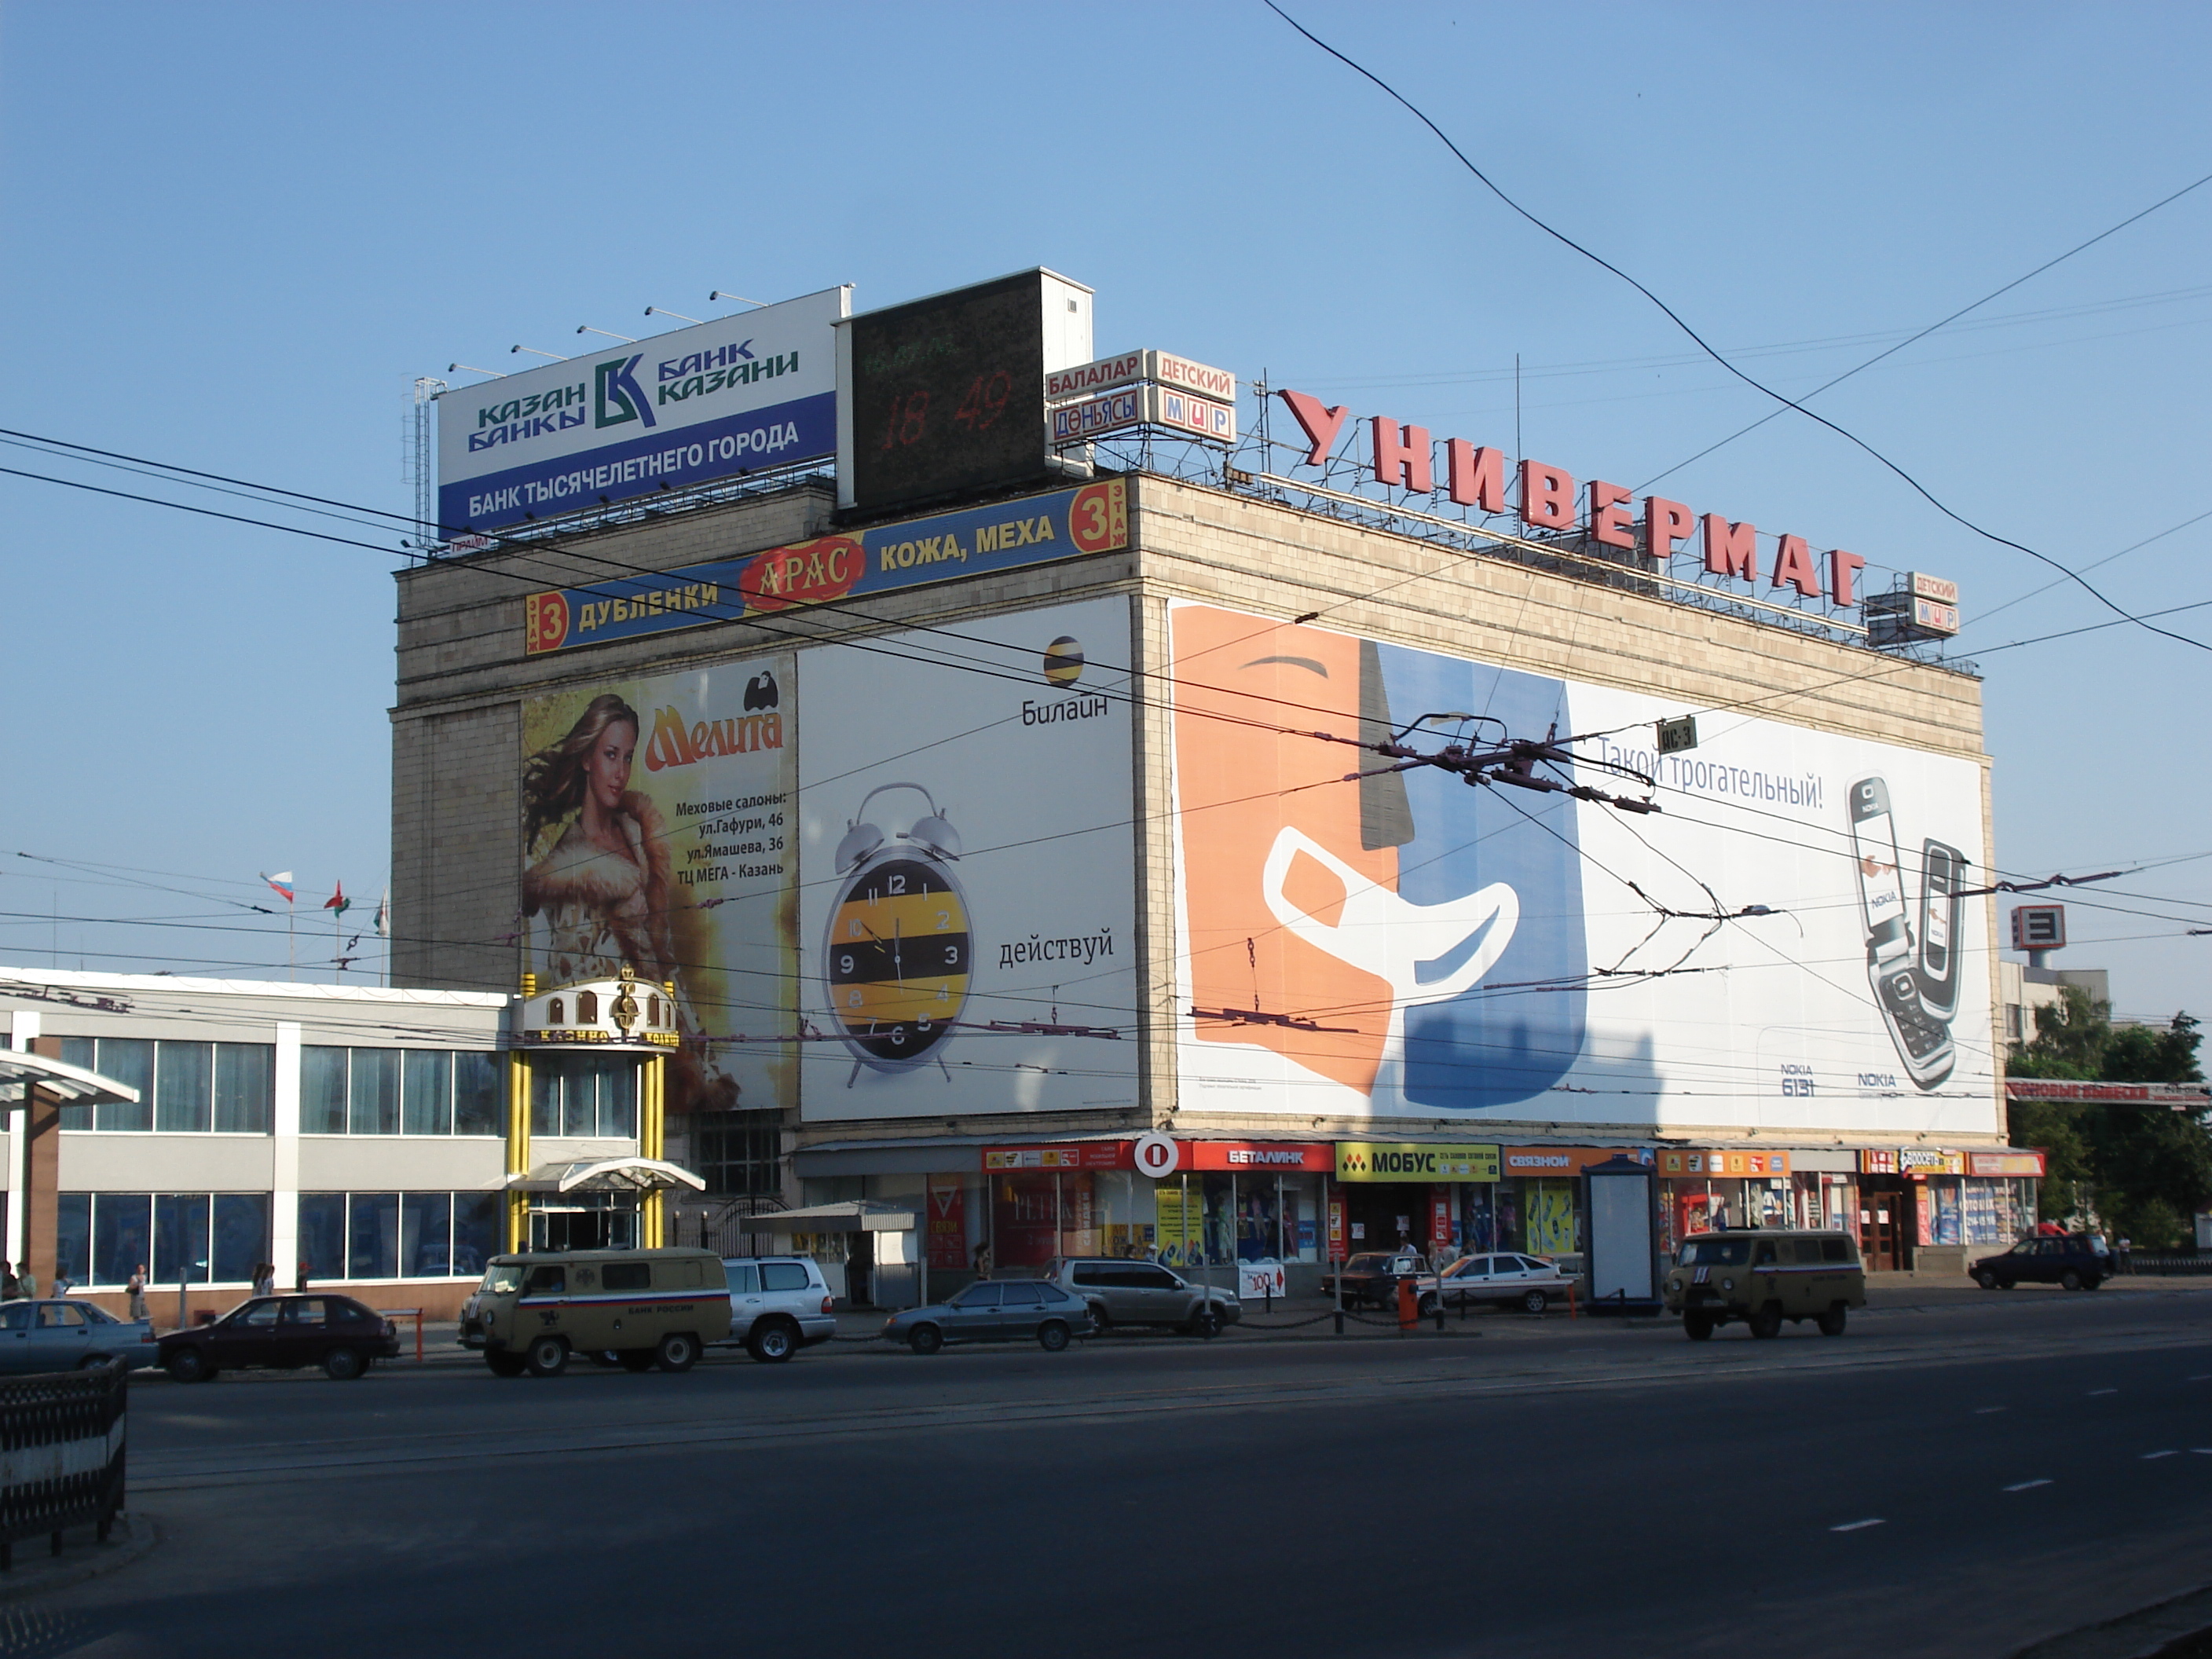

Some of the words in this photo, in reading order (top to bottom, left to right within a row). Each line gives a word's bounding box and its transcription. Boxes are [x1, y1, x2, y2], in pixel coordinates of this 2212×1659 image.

[658, 339, 755, 382] БАНК
[658, 351, 799, 405] КАЗАНИ
[1048, 355, 1139, 396] БАЛАЛАР
[1161, 356, 1231, 395] ДЕТСКИЙ
[478, 383, 586, 428] КАЗАН
[881, 391, 930, 450] 18
[954, 370, 1013, 430] 49
[1166, 393, 1227, 434] МИР
[468, 406, 586, 453] БАНКЫ
[469, 484, 521, 518] БАНК
[525, 442, 704, 504] ТЫСЯЧЕЛЕТНЕГО
[708, 420, 800, 463] ГОРОДА
[1277, 388, 1866, 607] УНИВЕРМАГ
[1081, 496, 1108, 541] 3
[1112, 486, 1126, 545] ЭТАЖ
[880, 532, 968, 572] КОЖА,
[976, 514, 1056, 553] МЕХА
[757, 547, 850, 598] АРАС
[1917, 576, 1957, 600] ДЕТСКИЙ
[579, 581, 720, 632] ДУБЛЕНКИ
[1918, 601, 1957, 628] МИР
[528, 600, 539, 653] ЭТАЖ
[540, 605, 562, 641] 3
[645, 705, 784, 772] Мелита
[1670, 752, 1825, 811] трогательный!
[676, 799, 733, 817] Меховые
[735, 793, 786, 811] салоны:
[698, 818, 766, 838] ул.Гафури,
[767, 815, 784, 828] 46
[687, 840, 766, 864] ул.Ямашева,
[769, 838, 784, 851] 36
[677, 870, 694, 886] ТЦ
[697, 868, 729, 884] МЕГА
[739, 863, 784, 880] Казань
[888, 874, 906, 894] 12
[1870, 890, 1898, 910] NOKIA
[936, 911, 950, 930] 2
[943, 946, 958, 965] 3
[998, 928, 1115, 969] действуй
[840, 954, 855, 974] 9
[848, 989, 863, 1009] 8
[892, 1025, 905, 1046] 6
[1780, 1064, 1814, 1076] NOKIA
[1858, 1072, 1897, 1088] NOKIA
[1782, 1078, 1815, 1097] 6131
[1228, 1150, 1305, 1164] БЕТАЛИНК
[1372, 1152, 1437, 1173] МОБУС
[1509, 1153, 1569, 1168] СВЯЗНОЙ
[1253, 1273, 1271, 1291] 100
[657, 1305, 694, 1313] РОССИИ
